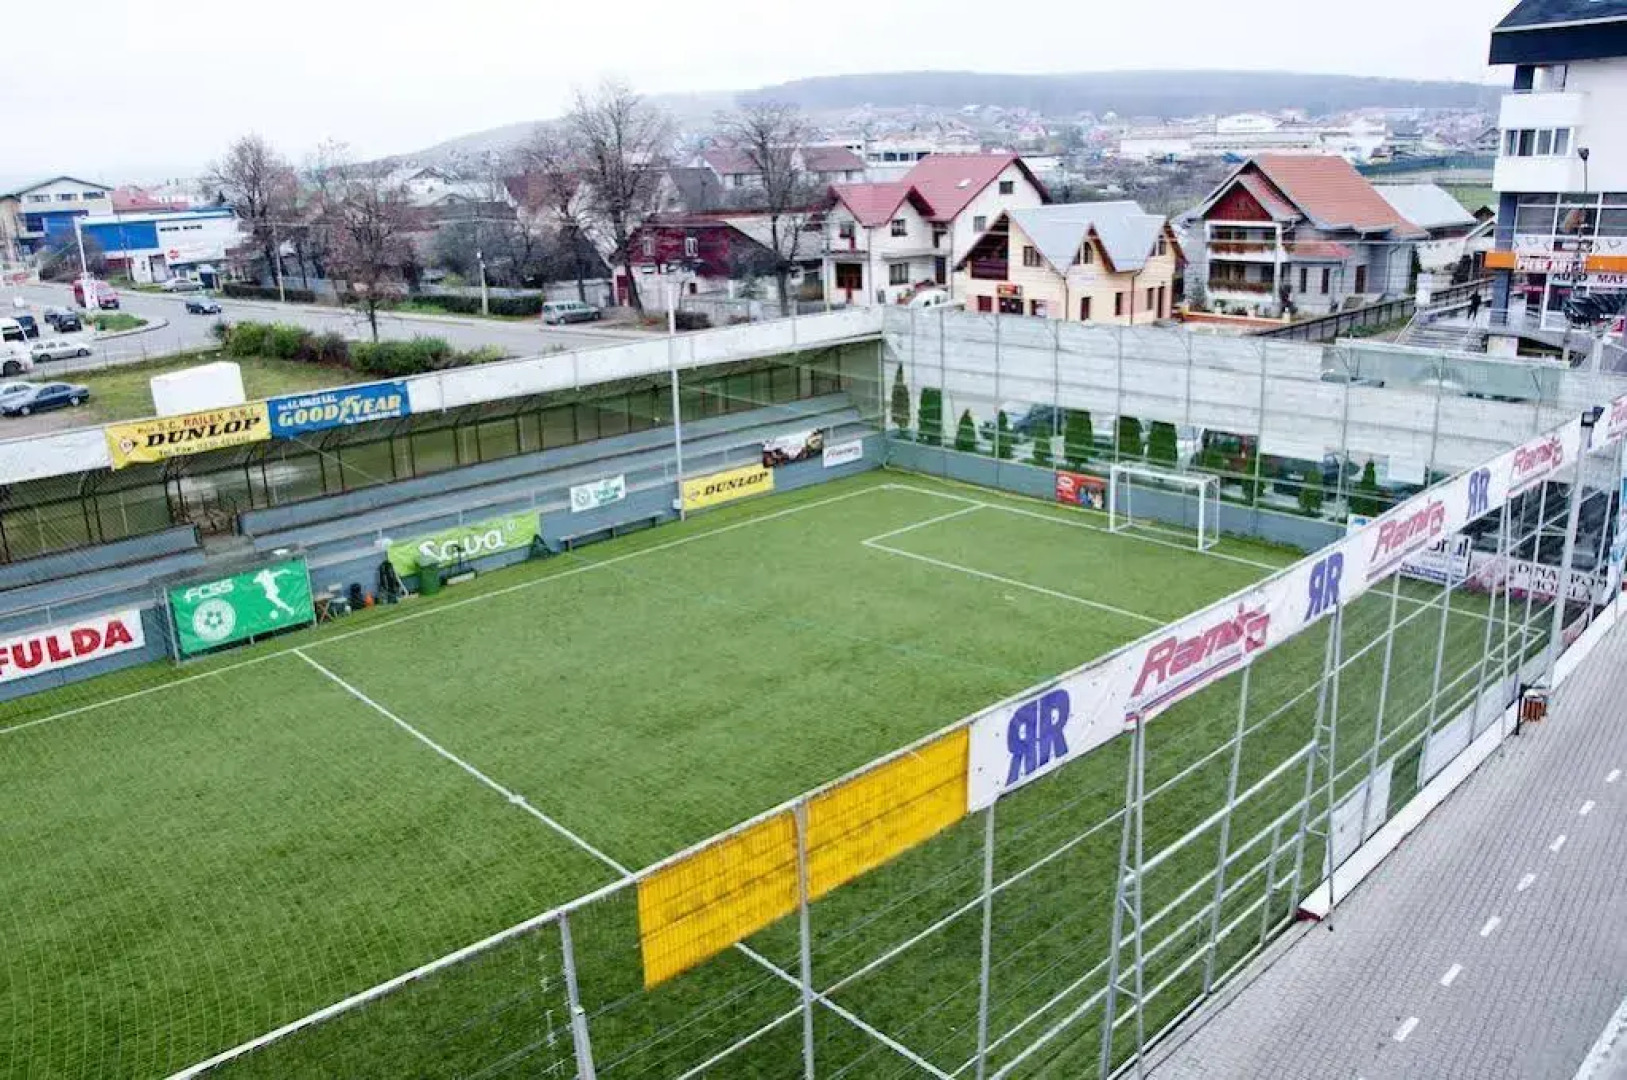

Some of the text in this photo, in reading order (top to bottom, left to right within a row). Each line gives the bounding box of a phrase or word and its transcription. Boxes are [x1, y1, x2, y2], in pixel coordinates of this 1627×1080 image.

[277, 394, 402, 427] GOODYEAR
[145, 416, 261, 448] DUNLOP
[704, 471, 769, 496] DUNLOP
[0, 619, 133, 676] FULDA
